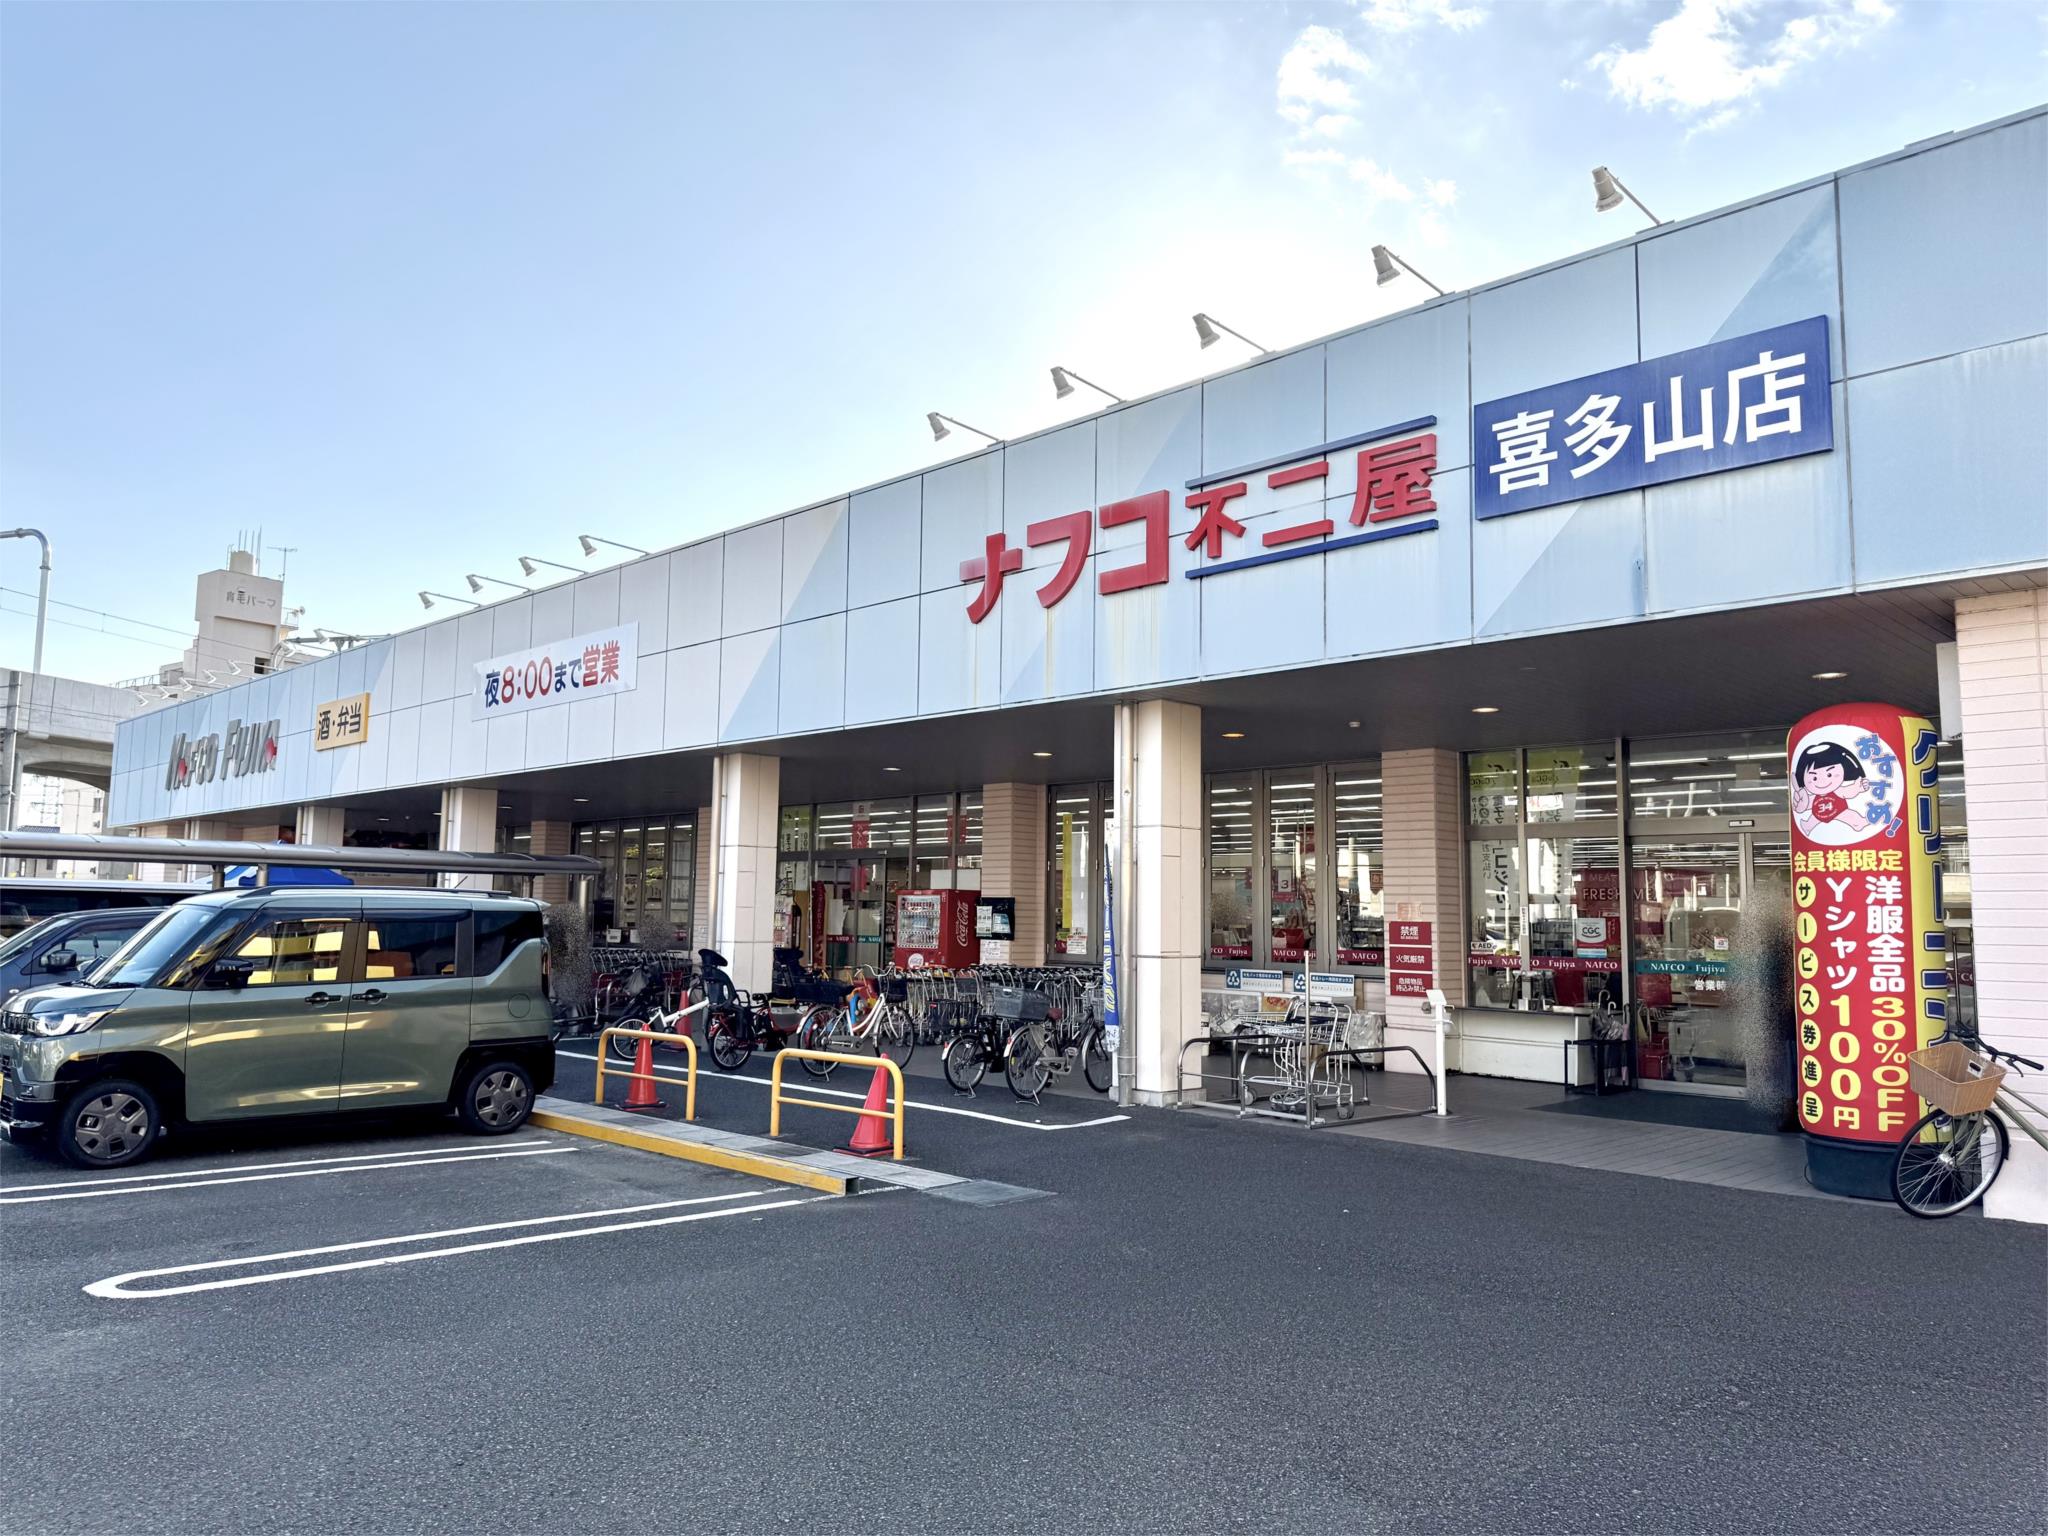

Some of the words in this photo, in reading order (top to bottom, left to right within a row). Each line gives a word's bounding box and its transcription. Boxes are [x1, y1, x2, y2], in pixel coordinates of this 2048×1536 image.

[1489, 351, 1807, 496] 喜多山店
[485, 640, 620, 708] 夜8:00まで営業
[317, 702, 362, 741] 酒・弁当
[1794, 849, 1904, 873] 会員様限定
[1400, 926, 1419, 936] 禁煙
[1582, 926, 1600, 936] CGC
[1352, 952, 1378, 960] NAFCO
[1548, 959, 1576, 969] Fujiya
[1585, 961, 1618, 969] NAFCO
[1650, 962, 1686, 972] NAFCO
[1695, 964, 1726, 975] Fujiya
[1798, 882, 1820, 1118] サービス券進呈
[1825, 877, 1862, 1131] Yシャツ100円
[1865, 875, 1909, 1132] 洋服全品30%OFF
